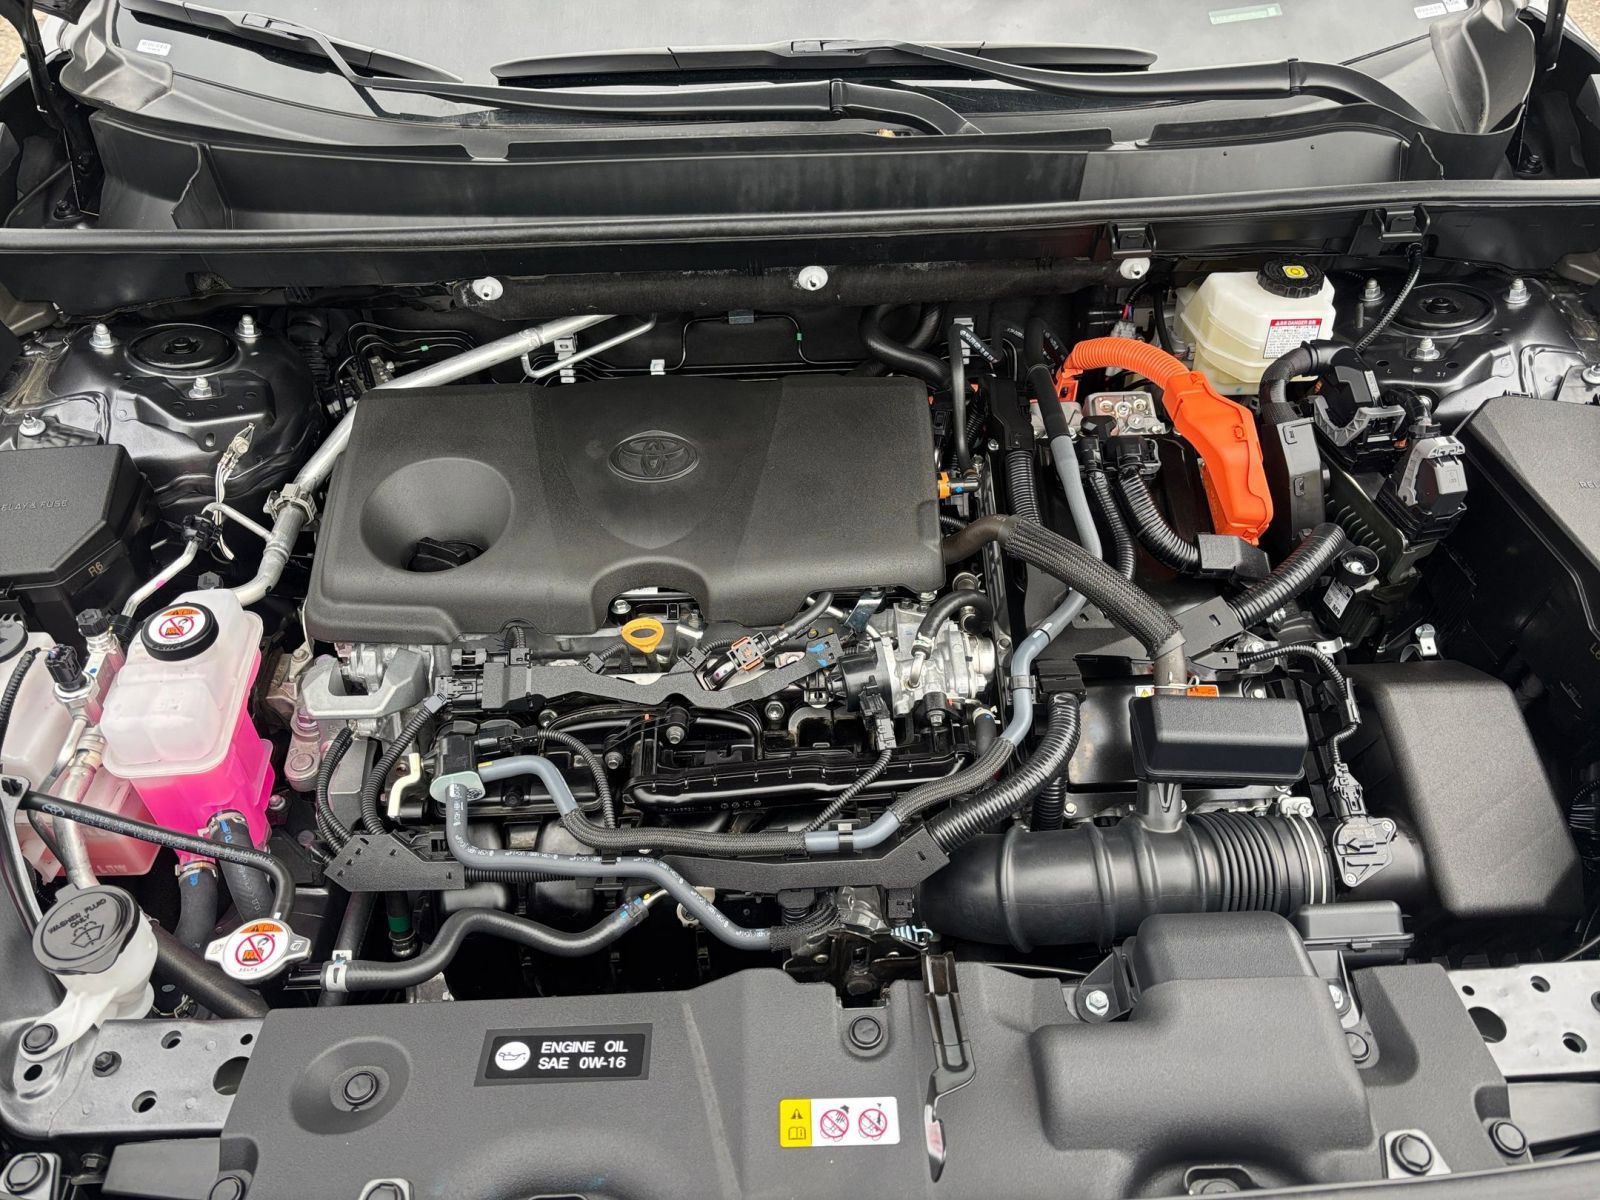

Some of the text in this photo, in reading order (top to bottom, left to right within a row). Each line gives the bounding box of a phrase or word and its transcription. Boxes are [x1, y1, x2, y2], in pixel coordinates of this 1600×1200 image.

[40, 499, 68, 508] FUSE
[88, 561, 104, 577] R6
[85, 812, 111, 824] WATER
[47, 898, 107, 935] WASHER FLUID
[70, 913, 90, 929] ONLY
[540, 1040, 629, 1054] ENGINE OIL
[537, 1056, 627, 1070] SAE 0W-16
